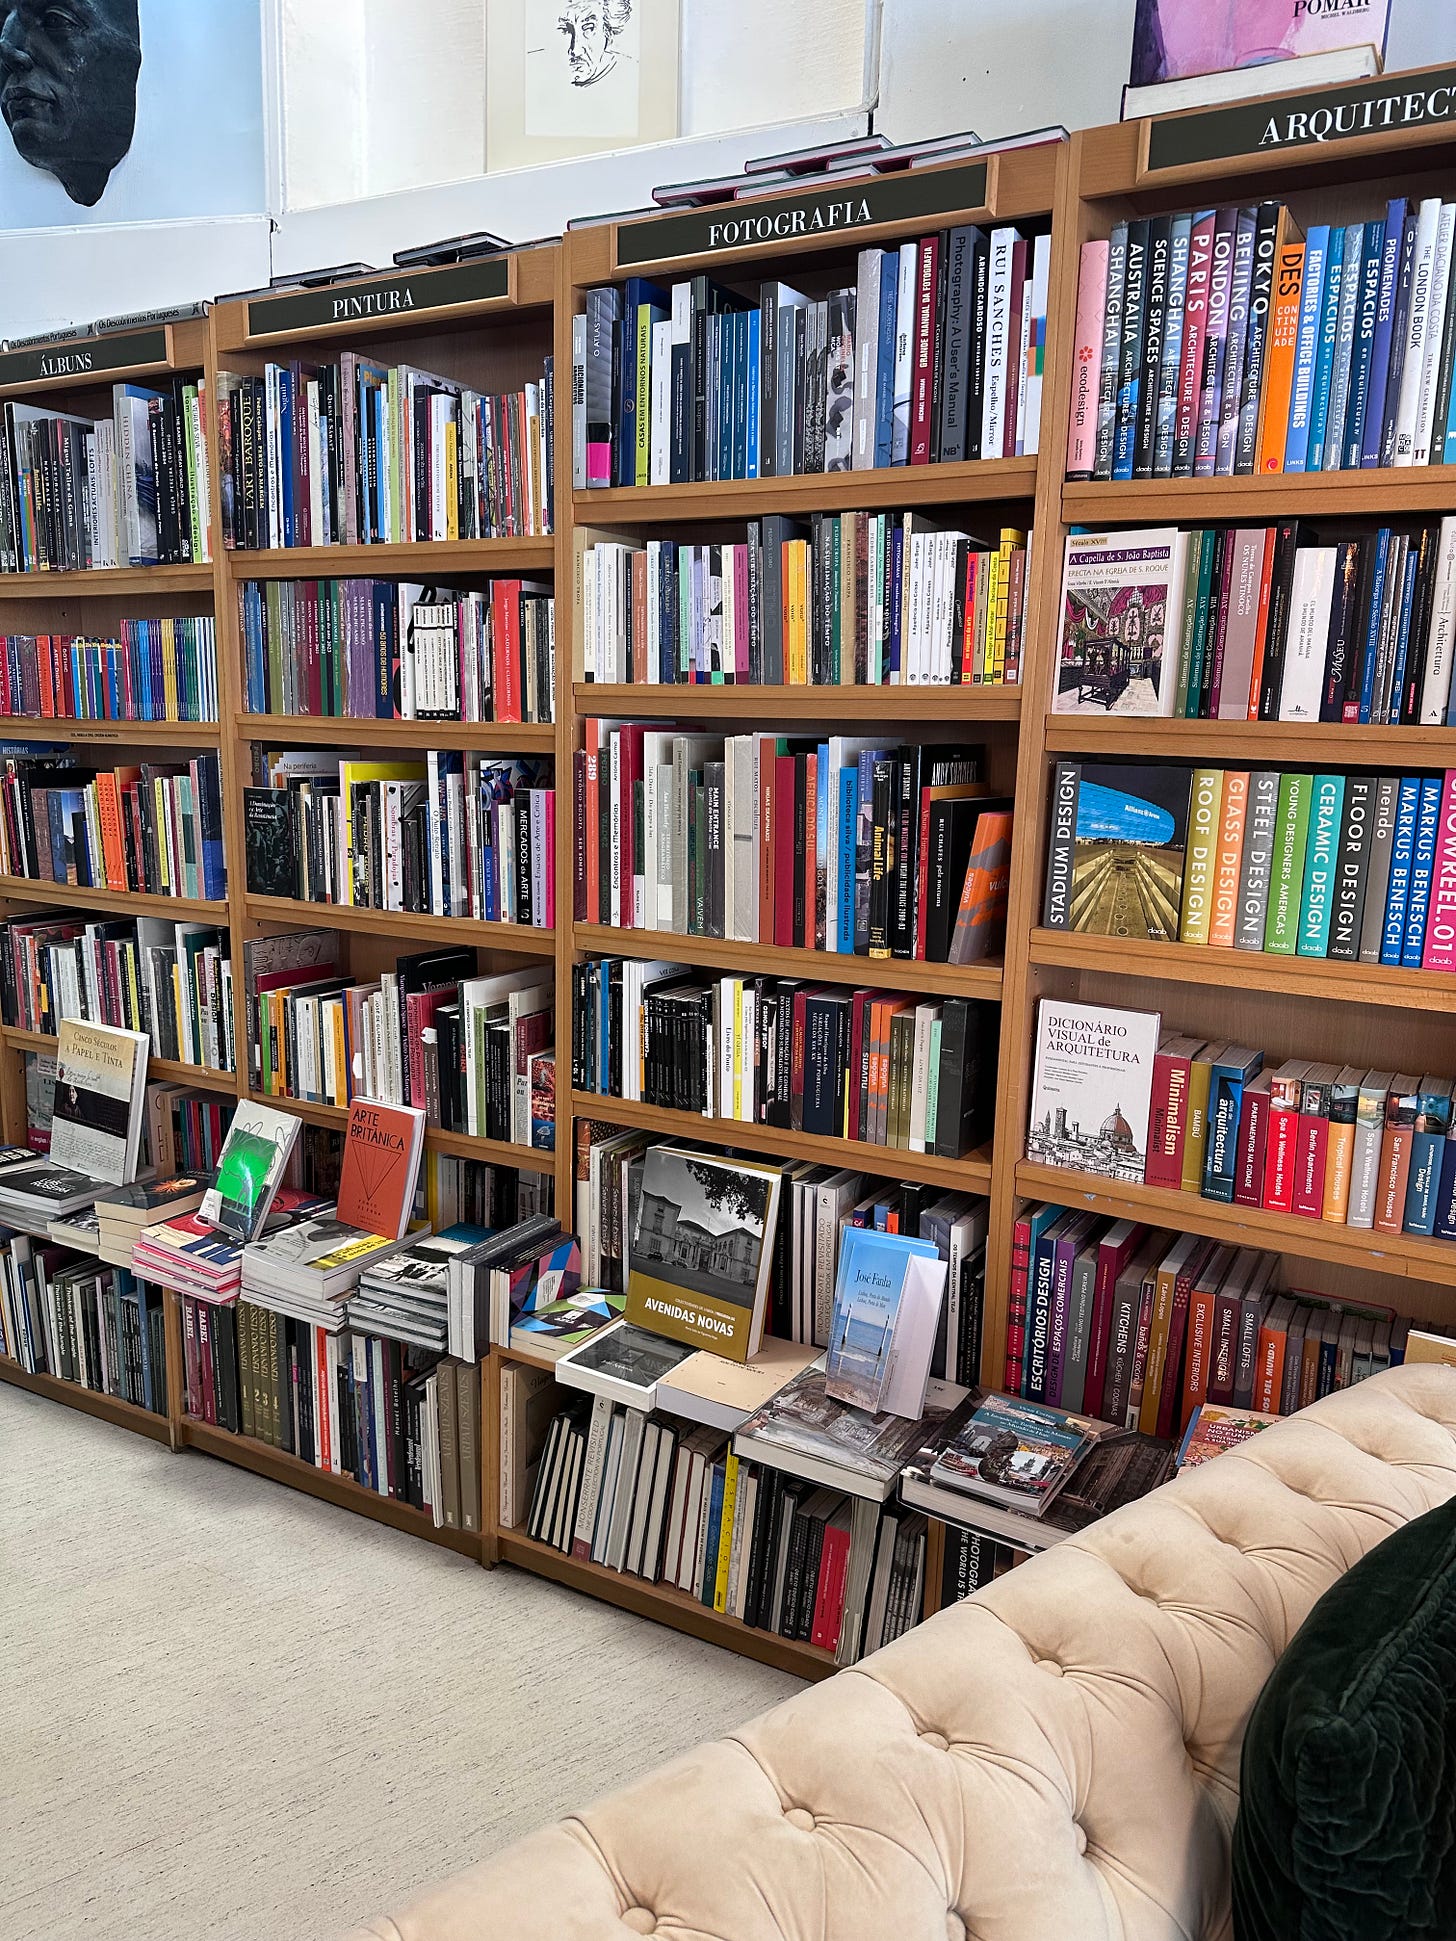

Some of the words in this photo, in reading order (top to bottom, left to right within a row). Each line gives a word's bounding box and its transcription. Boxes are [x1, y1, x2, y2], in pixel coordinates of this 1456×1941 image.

[1258, 88, 1456, 145] ARQUITEC
[708, 198, 872, 247] FOTOGRAFIA
[922, 246, 933, 291] FOTOGRAFIA
[995, 245, 1007, 276] RUI
[1150, 239, 1168, 302] SCIENCE
[1188, 235, 1210, 312] PARIS
[1253, 225, 1276, 315] TOKYO
[1279, 252, 1302, 297] DES
[1424, 245, 1432, 260] THE
[922, 292, 930, 303] DA
[950, 236, 966, 324] Photography:
[1104, 245, 1124, 348] SHANGHAI
[1123, 243, 1144, 344] AUSTRALIA
[1165, 237, 1188, 341] SHANGHAI
[1209, 232, 1232, 325] LONDON
[1230, 232, 1252, 322] BEIJING
[1303, 250, 1322, 314] FACTORIES
[1361, 259, 1380, 339] ESPACIOS
[1379, 238, 1397, 322] PROMENADES
[1414, 263, 1429, 313] LONDON
[332, 288, 414, 319] PINTURA
[920, 304, 930, 336] MANUAL
[976, 294, 984, 332] CARDOSO
[990, 284, 1005, 367] SANCHES
[1276, 317, 1296, 325] TIN
[1277, 305, 1298, 315] CON
[1306, 315, 1314, 324] &
[1325, 265, 1341, 344] ESPACIOS
[920, 338, 929, 368] GRANDE
[951, 327, 962, 336] A
[1146, 308, 1162, 364] SPACES
[1274, 337, 1295, 346] ADE
[1275, 327, 1295, 336] UID
[1300, 325, 1314, 365] OFFICE
[1410, 317, 1424, 349] BOOK
[40, 353, 92, 376] ÁLBUNS
[950, 340, 961, 379] User's
[1183, 324, 1199, 403] ARCHITECTURE
[639, 410, 645, 421] EM
[947, 382, 959, 428] Manual
[989, 375, 999, 444] Espelho/Mirror
[1075, 366, 1089, 426] ecodesign
[1182, 404, 1189, 413] &
[1292, 368, 1311, 429] BUILDINGS
[243, 396, 254, 465] BAROQUE
[1178, 416, 1190, 457] DESIGN
[245, 474, 254, 509] L'ART
[90, 507, 98, 546] INTERIORES
[1069, 555, 1077, 564] A
[1079, 552, 1105, 564] Capella
[1106, 553, 1115, 561] de
[1116, 552, 1124, 560] S.
[1125, 551, 1140, 560] João
[1143, 548, 1169, 559] Baptista
[1241, 559, 1249, 586] NUNES
[283, 762, 295, 770] Na
[296, 761, 318, 771] periferia
[587, 755, 597, 781] 289
[1057, 771, 1076, 839] DESIGN
[1194, 777, 1215, 835] ROOF
[1224, 778, 1244, 843] GLASS
[1252, 780, 1273, 839] STEEL
[1289, 780, 1300, 820] YOUNG
[1347, 785, 1368, 852] FLOOR
[1377, 785, 1392, 839] nendo
[520, 809, 528, 864] MERCADOS
[874, 825, 884, 864] Animal
[1314, 783, 1336, 864] CERAMIC
[1395, 786, 1417, 860] MARKUS
[1417, 786, 1439, 861] MARKUS
[391, 846, 399, 881] Paradojas
[873, 861, 883, 881] Life
[1281, 823, 1295, 880] DESIGNERS
[521, 877, 529, 900] ARTE
[963, 872, 974, 904] vulcões
[1050, 846, 1069, 924] STADIUM
[1187, 847, 1208, 925] DESIGN
[1215, 853, 1237, 927] DESIGN
[1243, 851, 1265, 931] DESIGN
[1305, 871, 1327, 938] DESIGN
[1337, 864, 1360, 941] DESIGN
[1386, 868, 1407, 945] BENESCH
[1276, 883, 1289, 935] AMERICAS
[1407, 869, 1429, 947] BENESCH
[74, 1032, 92, 1044] CINCO
[1048, 1016, 1127, 1038] DICIONÁRIO
[1048, 1029, 1094, 1045] VISUAL
[1098, 1037, 1111, 1047] de
[72, 1043, 93, 1060] PAPEL
[102, 1052, 123, 1068] TINTA
[1047, 1040, 1140, 1064] ARQUITETURA
[352, 1107, 380, 1127] ARTE
[1152, 1108, 1164, 1153] Minimalist
[1164, 1069, 1185, 1156] Minimalism
[350, 1123, 405, 1151] BRITÂNICA
[1214, 1098, 1229, 1174] arquitectura
[1309, 1129, 1318, 1150] Berlin
[1336, 1137, 1346, 1166] Tropical
[1394, 1137, 1402, 1150] San
[1305, 1151, 1315, 1195] Apartments
[1333, 1167, 1342, 1200] Houses
[1388, 1152, 1400, 1189] Francisco
[1385, 1190, 1394, 1218] Houses
[855, 1269, 871, 1285] José
[872, 1272, 892, 1288] Fanha
[1038, 1257, 1051, 1306] DESIGN
[1056, 1259, 1068, 1312] COMERCIAIS
[185, 1306, 194, 1339] BABEL
[199, 1309, 208, 1344] BABEL
[644, 1296, 696, 1324] AVENIDAS
[697, 1315, 734, 1337] NOVAS
[1053, 1314, 1063, 1352] ESPAÇOS
[1117, 1302, 1131, 1354] KITCHENS
[1193, 1303, 1206, 1348] EXCLUSIVE
[1244, 1312, 1255, 1340] SMALL
[1031, 1307, 1047, 1391] ESCRITÓRIOS
[1190, 1351, 1201, 1392] INTERIORS
[1241, 1343, 1251, 1368] LOFTS
[578, 1466, 593, 1529] MONSERRATE
[587, 1420, 600, 1465] REVISITED
